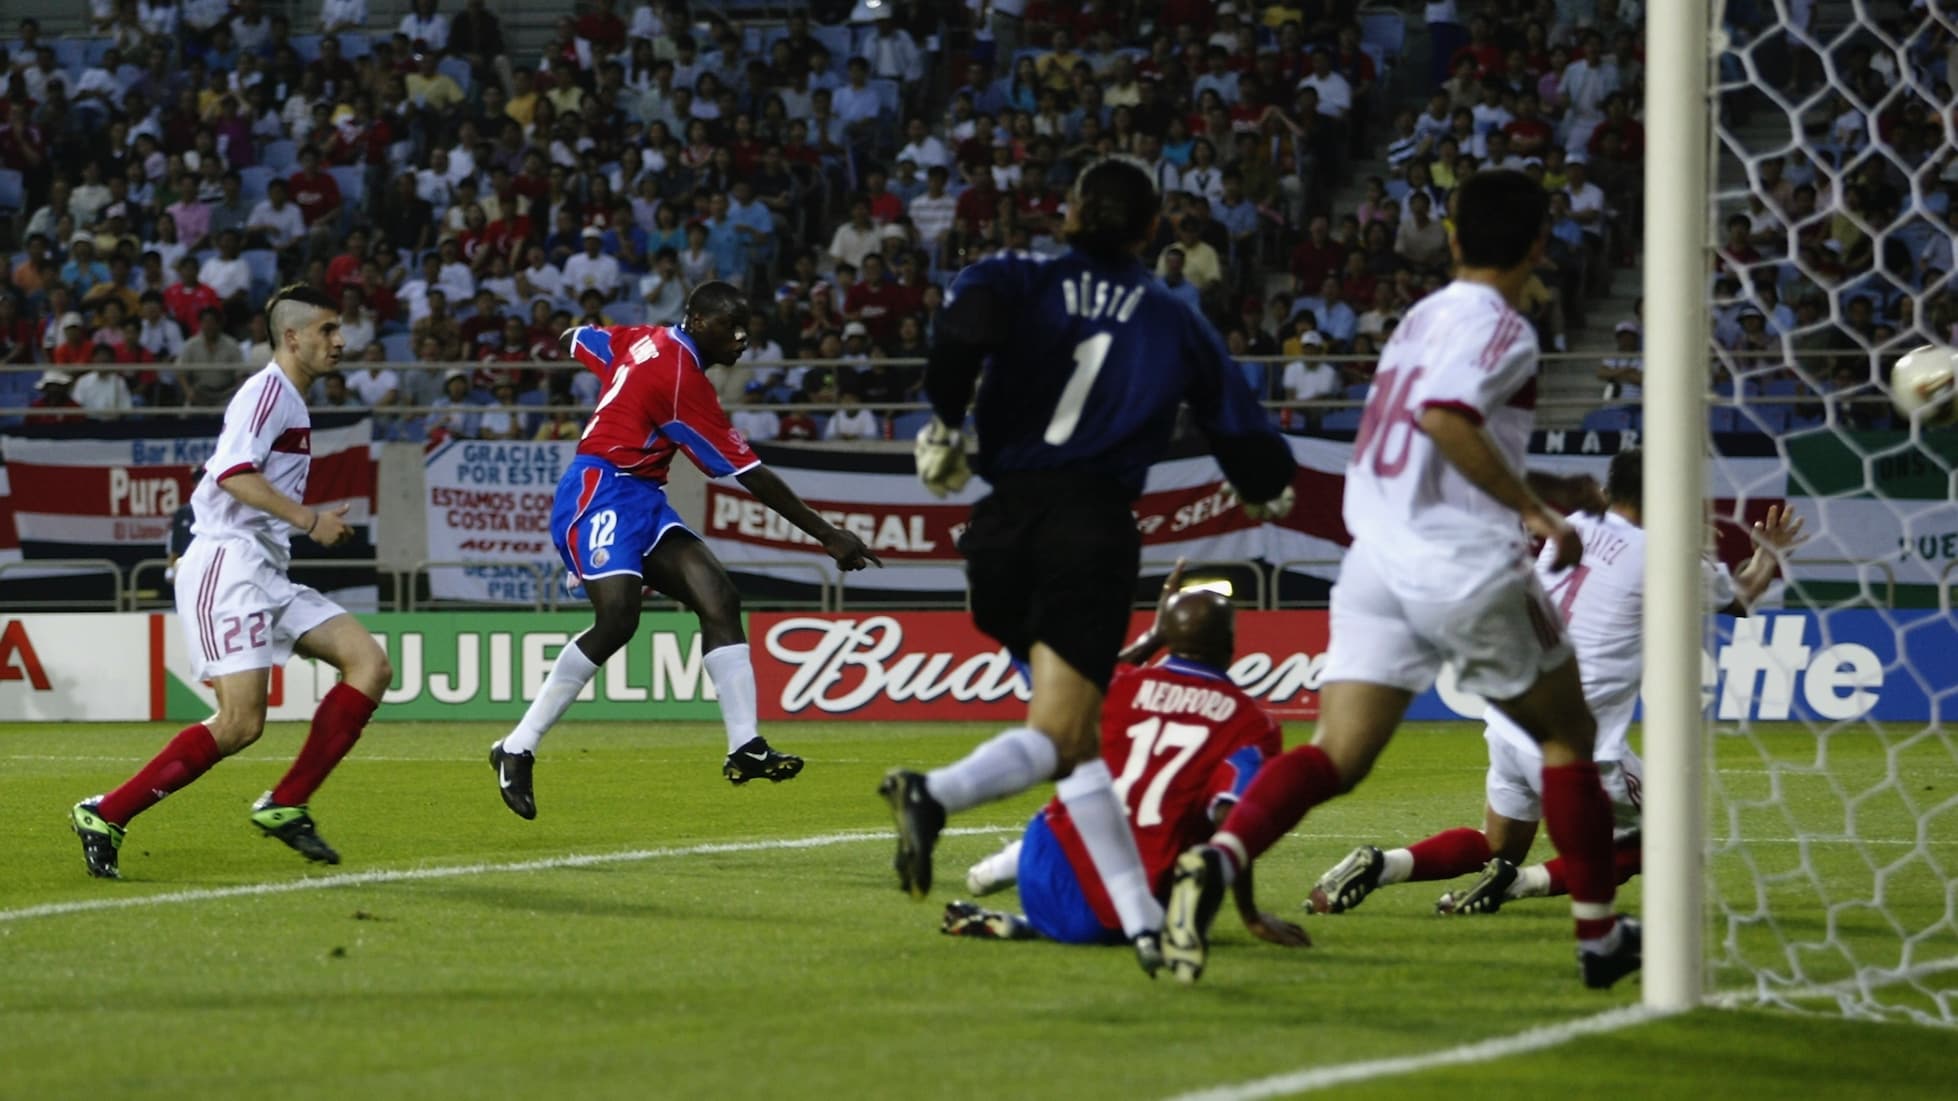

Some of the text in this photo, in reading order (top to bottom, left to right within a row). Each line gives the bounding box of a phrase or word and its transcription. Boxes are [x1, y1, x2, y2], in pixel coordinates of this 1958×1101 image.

[1044, 332, 1112, 446] 1
[457, 465, 558, 485] POR ESTE
[463, 444, 561, 465] GRACIAS
[109, 466, 179, 516] Pura
[432, 487, 516, 513] ESTAMOS
[447, 509, 550, 533] COSTA RIC
[588, 509, 617, 551] 12
[223, 611, 267, 654] 22
[314, 632, 718, 703] UJIFLM
[1131, 679, 1237, 723] MEDFORD
[1112, 715, 1210, 827] 17
